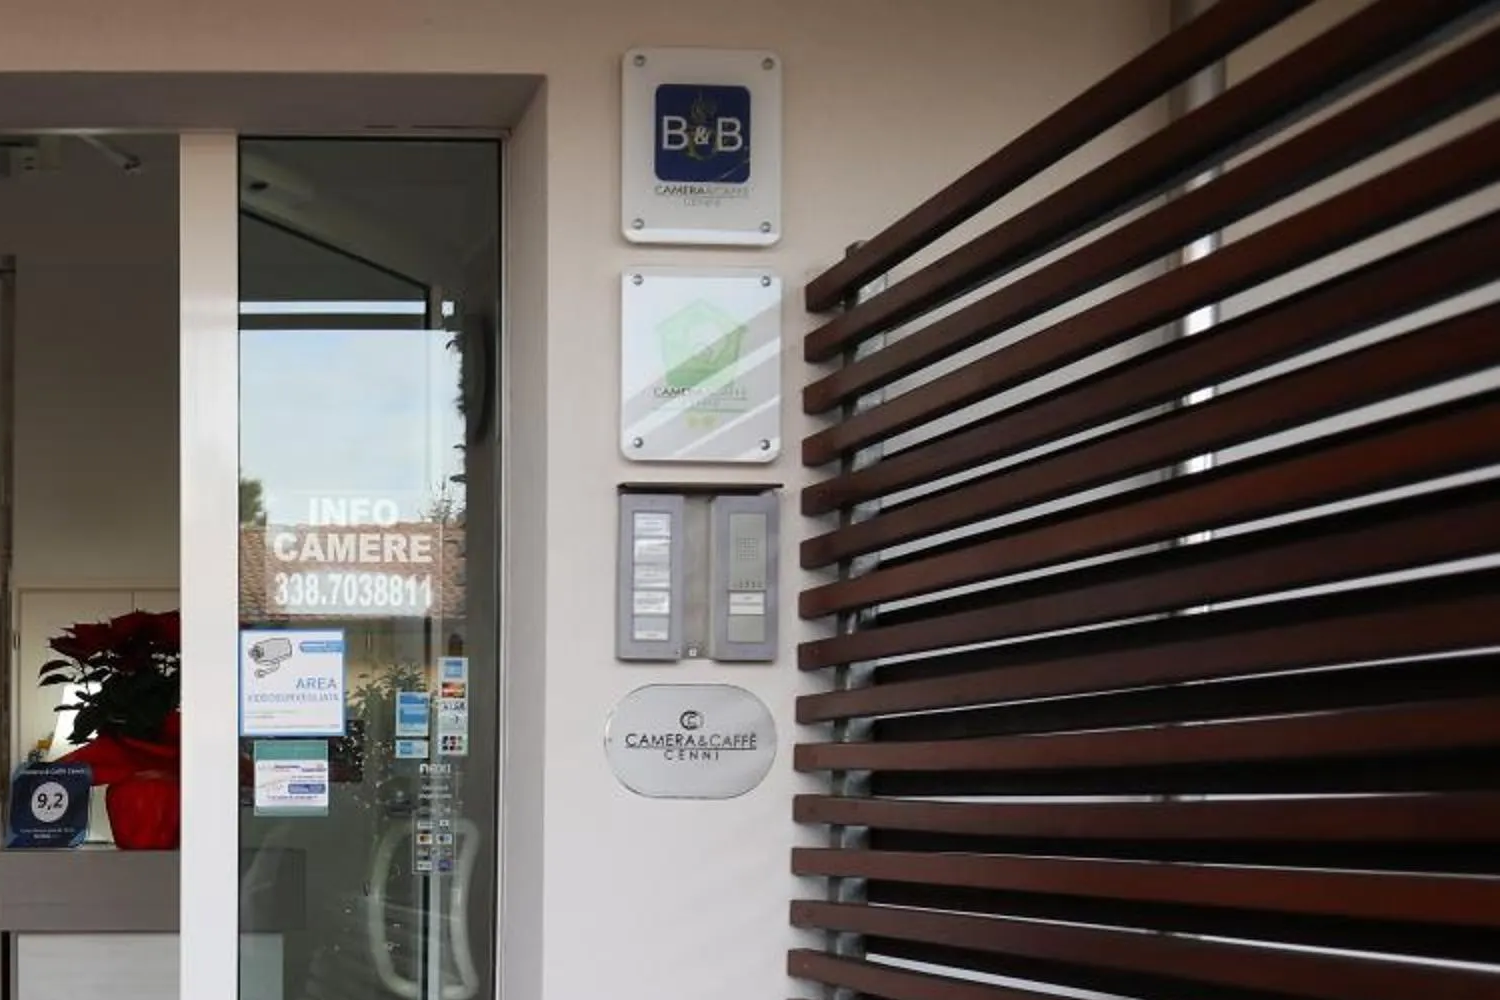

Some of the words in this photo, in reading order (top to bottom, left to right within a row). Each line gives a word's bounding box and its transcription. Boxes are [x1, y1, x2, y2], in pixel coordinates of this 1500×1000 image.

[662, 115, 743, 152] B&B
[309, 498, 399, 526] INFO
[273, 532, 434, 563] CAMERE
[274, 571, 433, 607] 338.7038811
[295, 677, 338, 690] AREA
[663, 748, 719, 761] CENNI
[37, 793, 63, 811] 9,2
